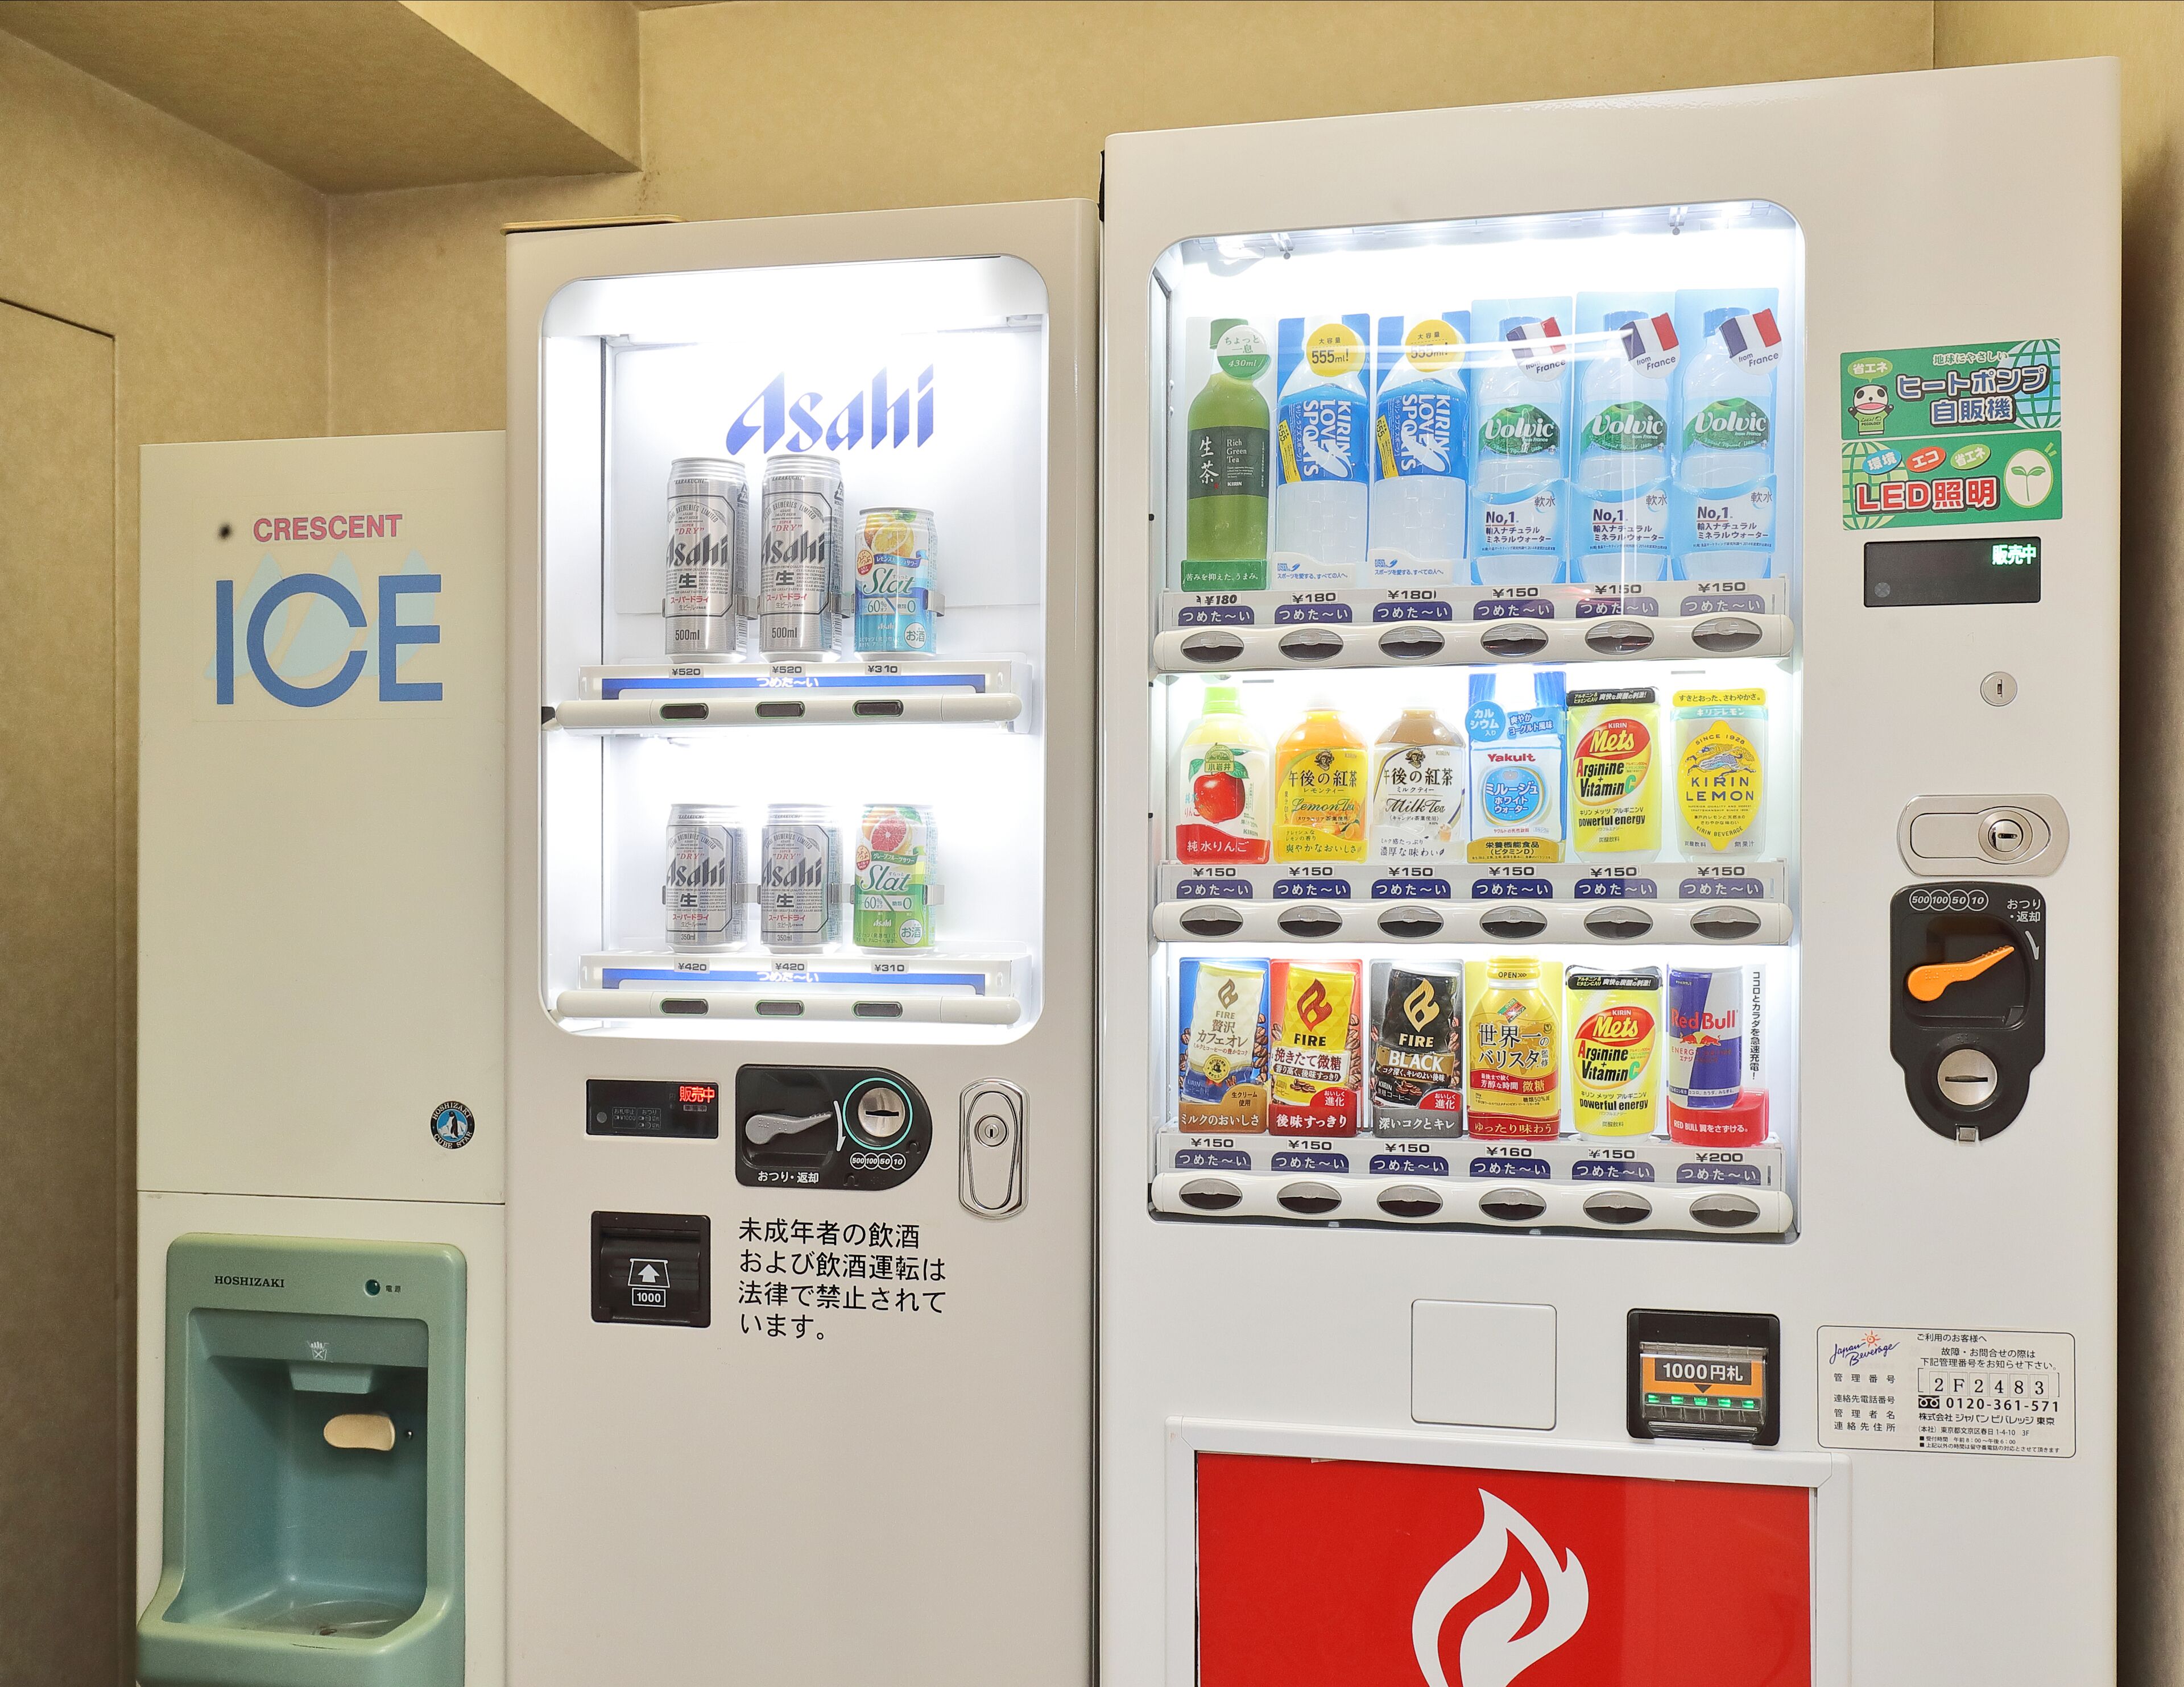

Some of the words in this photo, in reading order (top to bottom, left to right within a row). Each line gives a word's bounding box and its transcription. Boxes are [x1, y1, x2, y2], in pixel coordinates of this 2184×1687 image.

[1225, 335, 1260, 345] ちょっと
[1637, 357, 1651, 366] from
[1647, 356, 1676, 370] France
[1738, 353, 1753, 363] from
[1749, 353, 1778, 367] France
[1934, 351, 2008, 365] 地球にやさしい
[1537, 360, 1566, 374] France
[1853, 362, 1887, 375] 省エネ
[1897, 365, 2047, 398] ヒートポンプ
[726, 364, 933, 455] Asahi
[1932, 397, 2012, 423] 自販機
[1485, 418, 1554, 439] Volvic
[1592, 415, 1663, 436] Volvic
[1695, 412, 1767, 433] Volvic
[1867, 452, 1897, 470] 環境
[1913, 451, 1939, 468] エコ
[1955, 448, 1986, 465] 省エネ
[1859, 478, 1997, 511] LED照明
[254, 515, 402, 542] CRESCENT
[1992, 544, 2036, 565] 販売中
[679, 573, 697, 588] 生
[776, 570, 794, 586] 生
[1493, 588, 1538, 598] ¥150
[1698, 582, 1745, 592] ¥150
[1293, 592, 1336, 603] ¥180
[676, 630, 700, 640] 500ml
[772, 628, 797, 638] 500ml
[907, 631, 924, 642] お酒
[216, 574, 442, 707] ICE
[672, 668, 700, 676] ¥520
[773, 666, 802, 674] ¥520
[1474, 709, 1494, 718] カル
[1470, 719, 1499, 729] シウム
[1509, 720, 1553, 735] ヨーグルト風味
[1589, 729, 1634, 752] Mets
[1695, 735, 1720, 745] SINCE
[1726, 735, 1745, 744] 1928
[1577, 758, 1624, 777] Arginine
[1289, 770, 1356, 787] 午後の紅茶
[1384, 768, 1453, 786] 午後の紅茶
[1691, 777, 1748, 786] KIRIN
[1486, 781, 1538, 795] ミルージュ
[1686, 791, 1753, 801] LEMON
[1386, 798, 1425, 813] Milk
[1425, 800, 1445, 813] Tea
[1579, 816, 1612, 827] powerful
[1615, 815, 1645, 824] energy
[1697, 826, 1711, 835] KIRIN
[1714, 826, 1743, 836] BEVERAGE
[1188, 841, 1249, 852] 純水りんご
[861, 865, 911, 890] Slat
[1193, 868, 1236, 877] ¥150
[1289, 867, 1333, 876] ¥150
[1389, 868, 1433, 876] ¥150
[1490, 867, 1534, 876] ¥150
[1591, 867, 1637, 876] ¥150
[1698, 867, 1744, 876] ¥150
[680, 893, 697, 907] 生
[776, 893, 794, 907] 生
[2007, 900, 2041, 910] おつり
[901, 927, 920, 938] お酒
[679, 963, 706, 971] ¥420
[776, 963, 804, 971] ¥420
[875, 964, 905, 972] ¥310
[1213, 1020, 1235, 1033] 贅沢
[1592, 1016, 1638, 1037] Mets
[1197, 1030, 1248, 1047] カフェオレ
[1294, 1034, 1326, 1046] FIRE
[1399, 1033, 1434, 1047] FIRE
[1578, 1041, 1628, 1061] Arginine
[1275, 1048, 1341, 1070] 挽きたて微糖
[1389, 1050, 1443, 1072] BLACK
[1523, 1080, 1544, 1092] 微糖
[679, 1086, 715, 1102] 販売中
[1325, 1097, 1345, 1106] 進化
[1435, 1100, 1454, 1109] 進化
[1580, 1099, 1616, 1110] powerful
[1619, 1100, 1648, 1110] energy
[432, 1102, 472, 1120] HOSHIZAKI
[1181, 1114, 1259, 1126] ミルクのおいしさ
[1276, 1114, 1346, 1128] 後味すっきり
[1379, 1117, 1454, 1129] 深いコクとキレ
[1475, 1123, 1551, 1133] ゆったり味わう
[1685, 1122, 1698, 1131] BULL
[433, 1134, 452, 1149] CUBE
[456, 1131, 472, 1147] STAR
[1191, 1138, 1234, 1147] ¥150
[1289, 1140, 1331, 1150] ¥150
[1386, 1143, 1429, 1153] ¥150
[1487, 1147, 1531, 1157] ¥160
[739, 1217, 919, 1249] 未成年者の飲酒
[740, 1249, 945, 1280] および飲酒運転は
[214, 1276, 285, 1288] HOSHIZAKI
[637, 1292, 661, 1303] 1000
[739, 1280, 945, 1313] 法律で禁止されて
[741, 1314, 824, 1340] います。
[1917, 1333, 1987, 1342] ご利用のお客様へ
[1830, 1342, 1866, 1364] Japan
[1846, 1342, 1900, 1366] Beverage
[1941, 1348, 2036, 1358] 故障・お問合せの際は
[1921, 1358, 2056, 1370] 下記管理番号をお知らせ下さい。
[1663, 1363, 1743, 1381] 1000円札
[1834, 1395, 1895, 1404] 連絡先電話番号
[1946, 1398, 2058, 1412] 0120-361-571
[1919, 1413, 1953, 1421] 株式会社
[1956, 1414, 1988, 1423] ジャパン
[1992, 1416, 2033, 1424] ビバレッジ
